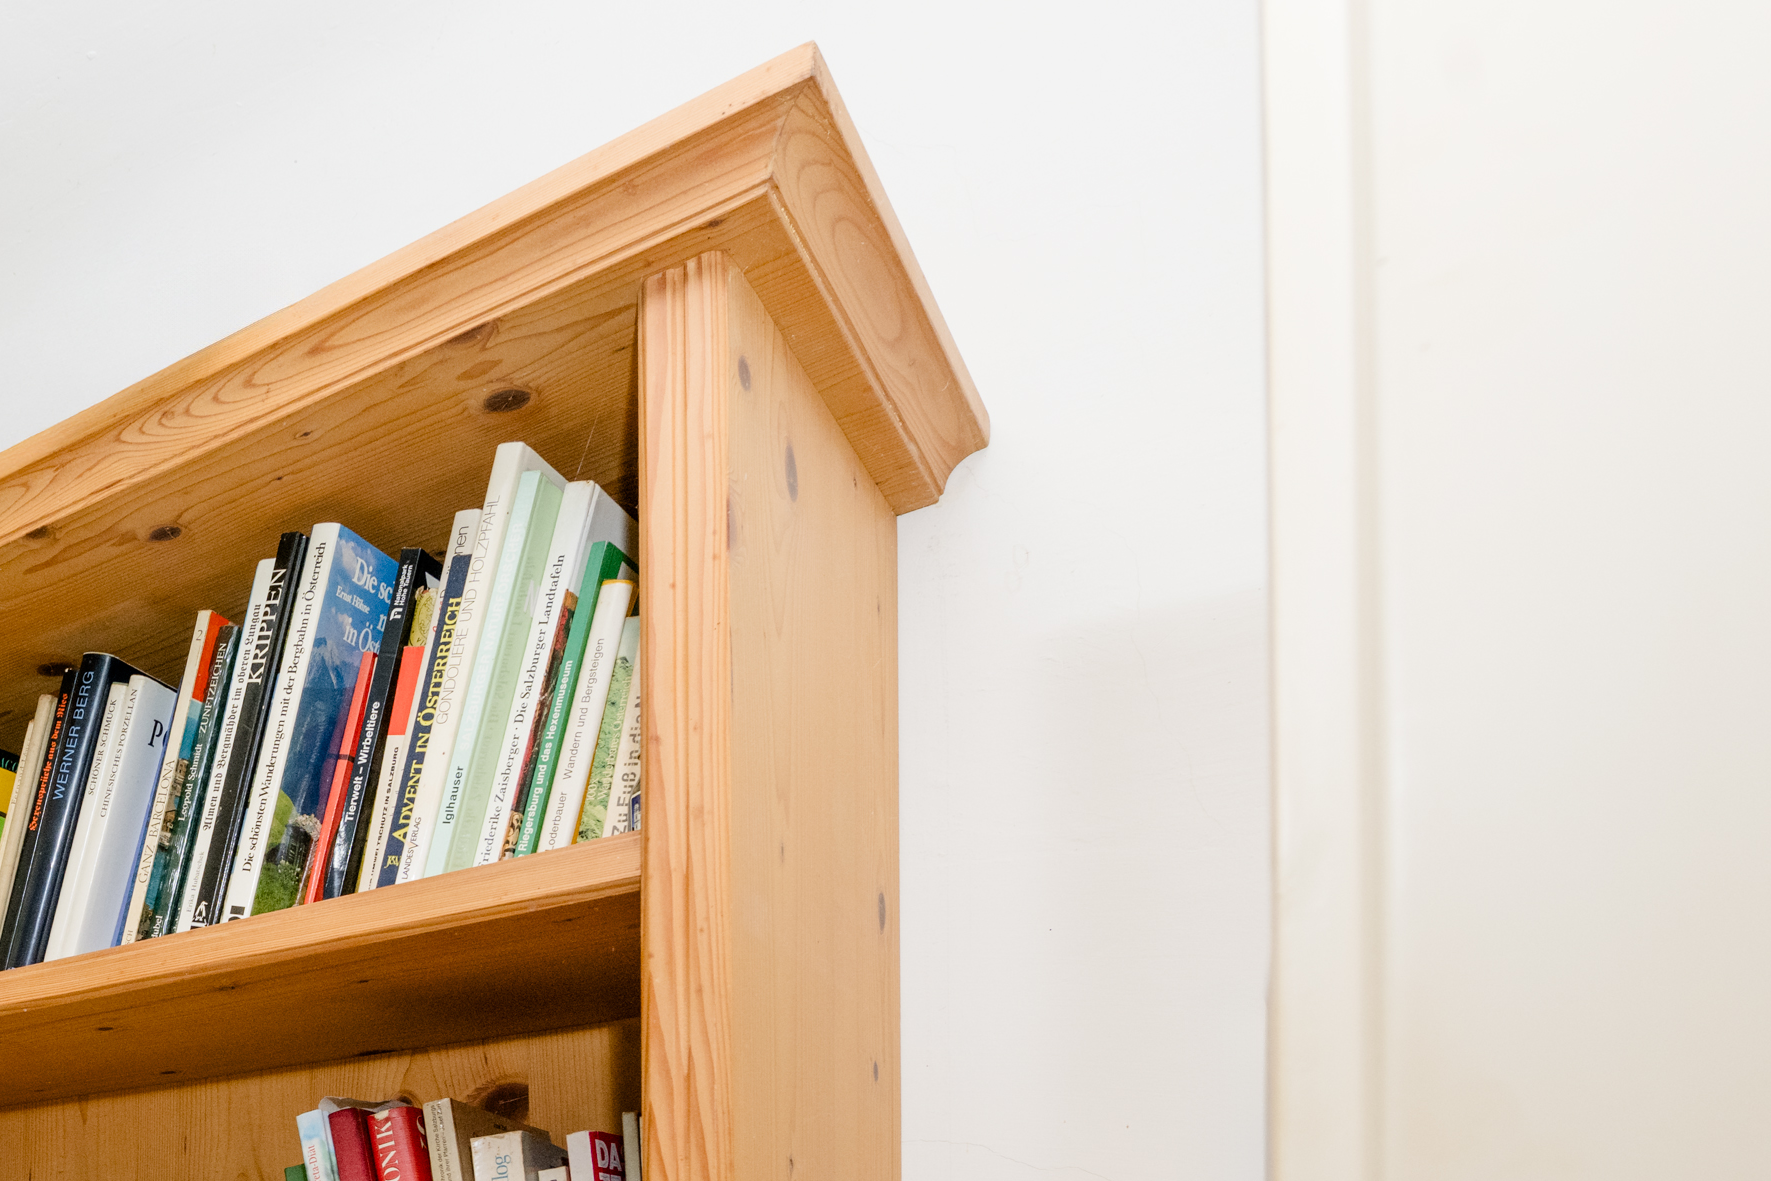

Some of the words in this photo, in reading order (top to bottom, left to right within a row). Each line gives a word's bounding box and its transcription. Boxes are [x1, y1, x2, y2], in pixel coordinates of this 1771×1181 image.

[303, 541, 327, 602] Österreich
[352, 557, 377, 589] Die
[394, 564, 408, 606] Nationalpark
[399, 588, 409, 607] Hohe
[404, 564, 414, 588] Tauern
[195, 629, 203, 641] 2
[247, 568, 287, 684] KRIPPEN
[299, 603, 312, 616] in
[343, 620, 358, 646] in
[436, 628, 469, 725] GONDOLIERE
[459, 588, 478, 625] UND
[470, 494, 501, 585] HOLZPFAHL
[288, 616, 308, 675] Bergbahn
[418, 596, 462, 730] ÖSTERREICH
[582, 638, 605, 704] Bergsteigen
[280, 694, 291, 717] mit
[284, 674, 296, 693] der
[494, 733, 519, 802] Zaisberger
[513, 703, 527, 725] Die
[520, 629, 547, 700] Salzburger
[538, 553, 566, 626] Landtafeln
[545, 660, 574, 740] Hexenmuseum
[51, 720, 62, 740] dem
[53, 726, 81, 800] WERNER
[73, 671, 95, 720] BERG
[88, 750, 103, 796] SCHÖNER
[100, 699, 117, 748] SCHMUCK
[179, 783, 194, 821] Leopold
[188, 743, 203, 781] Schmidt
[199, 642, 227, 735] ZUNFTZEICHEN
[213, 773, 224, 795] und
[232, 682, 242, 696] im
[416, 732, 431, 759] IN
[578, 707, 589, 730] und
[48, 741, 57, 760] aus
[100, 748, 123, 818] CHINESISCHES
[118, 689, 138, 747] PORZELLAN
[258, 718, 284, 798] Wanderungen
[345, 782, 364, 823] Tierwelt
[358, 701, 381, 767] Wirbeltiere
[387, 747, 400, 792] SALZBURG
[536, 765, 547, 785] und
[541, 739, 553, 761] das
[563, 732, 583, 781] Wandern
[137, 844, 155, 884] GANZ
[149, 759, 176, 839] BARCELONA
[248, 794, 265, 849] schönsten
[392, 759, 426, 844] ADVENT
[442, 765, 464, 825] Iglhauser
[518, 783, 540, 852] Riegersburg
[242, 850, 256, 873] Die
